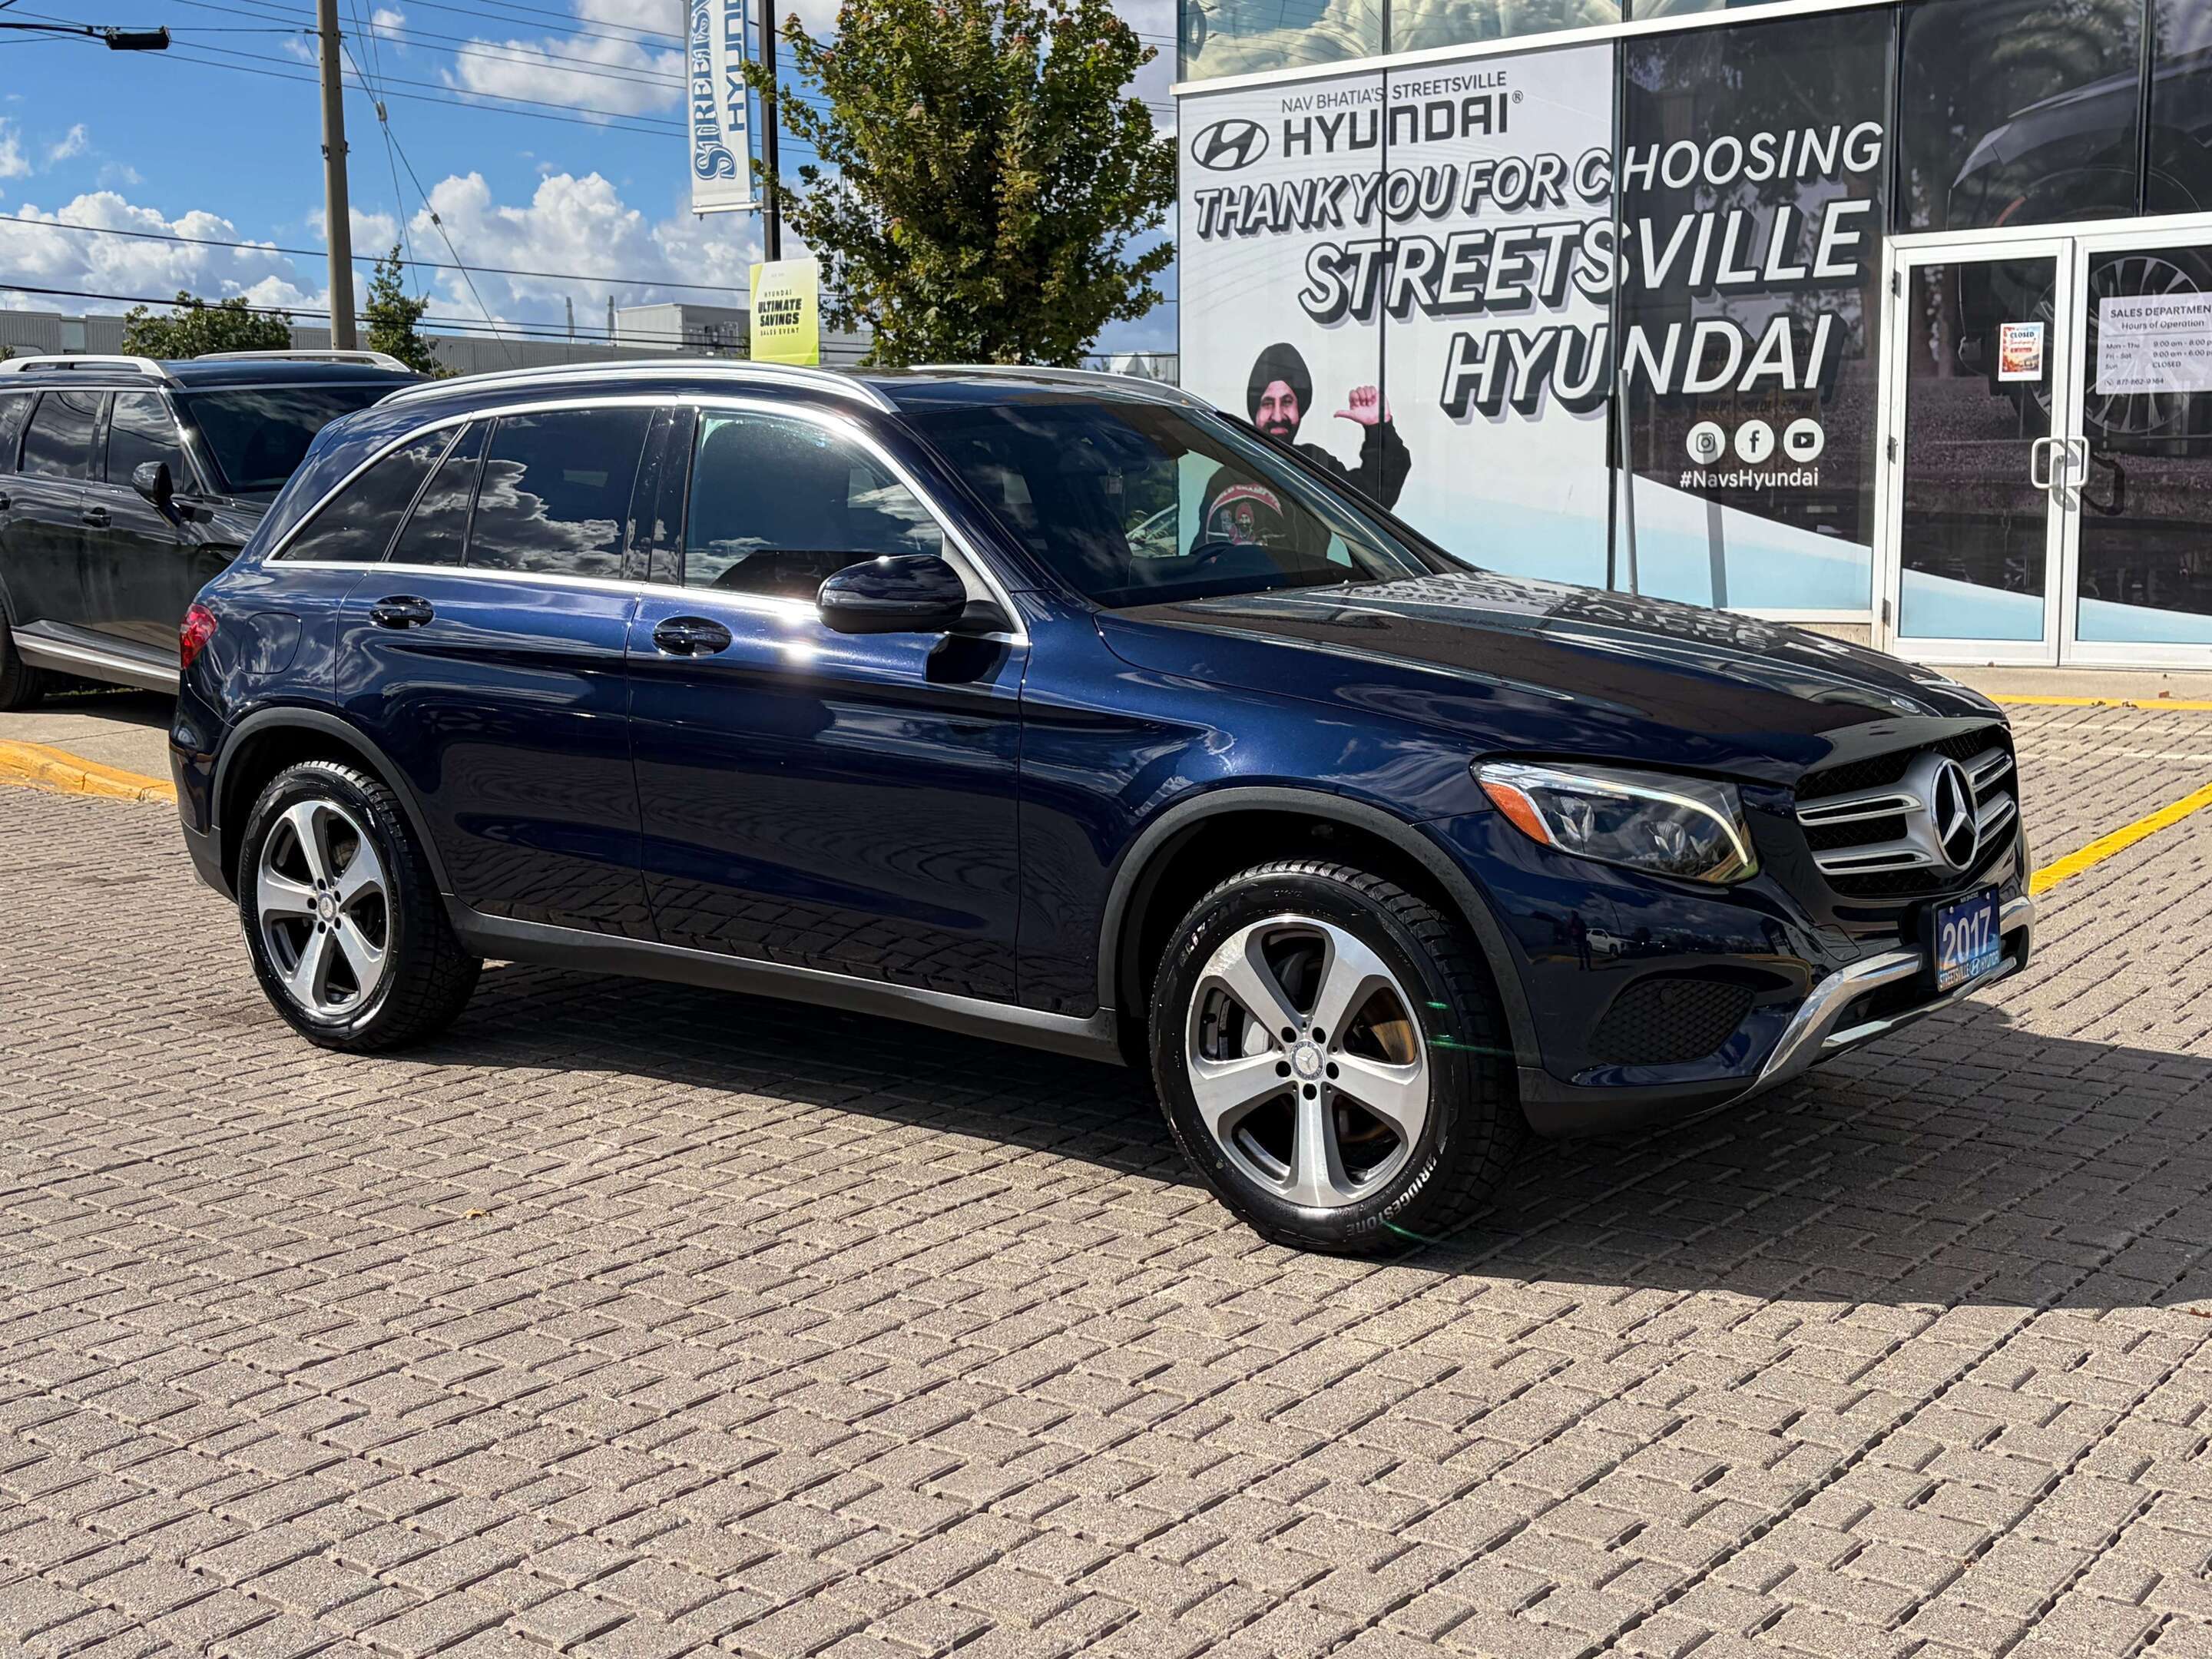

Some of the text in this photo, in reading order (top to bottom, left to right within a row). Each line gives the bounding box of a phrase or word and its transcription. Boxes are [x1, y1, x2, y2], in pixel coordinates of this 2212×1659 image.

[1281, 71, 1507, 114] NAV BHATIA'S STREETSVILLE
[1194, 121, 1884, 240] THANK YOU FOR CHOOSING
[1299, 198, 1872, 323] STREETSVILLE
[758, 298, 803, 313] ULTIMATE
[760, 312, 800, 327] SAVINGS
[2110, 305, 2212, 318] SALES DEPARTMEN
[2121, 322, 2147, 330] Hours
[2160, 320, 2204, 329] Operation
[1440, 313, 1837, 419] HYUNDAI
[1680, 467, 1820, 489] #NavsHyundai
[1942, 906, 1992, 971] 2017
[1346, 1153, 1438, 1236] BRIDGESTONE
